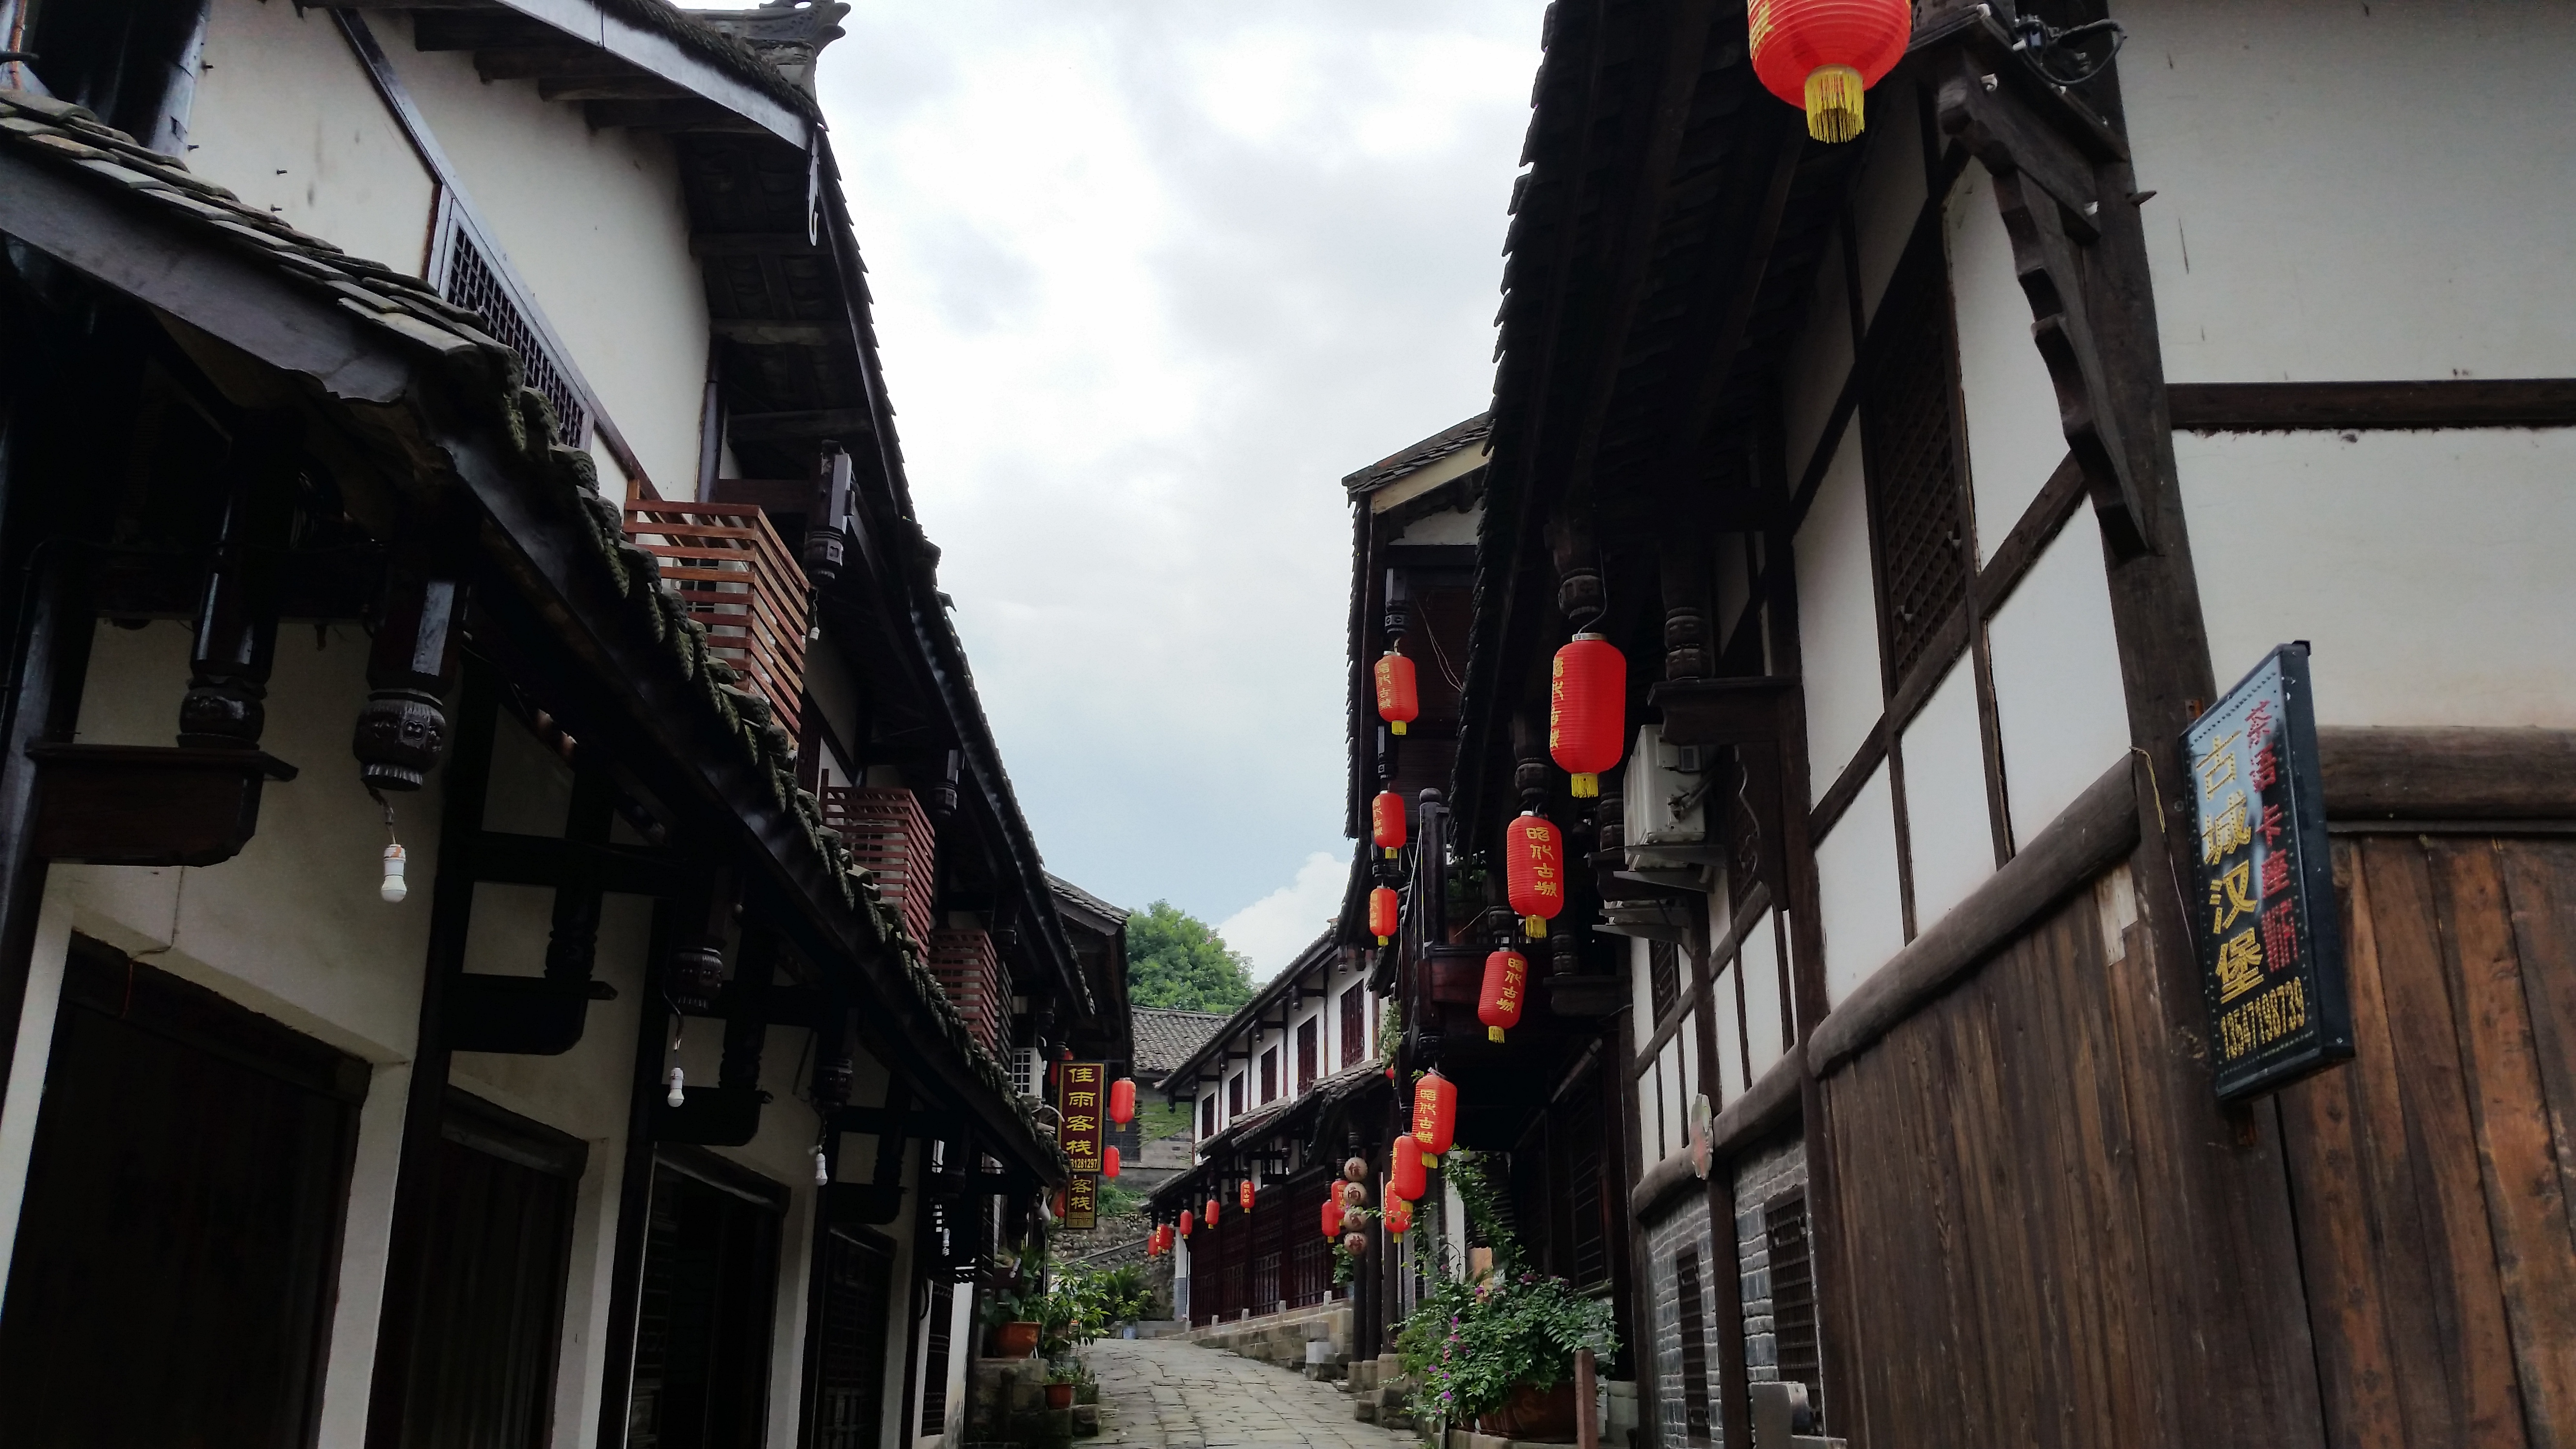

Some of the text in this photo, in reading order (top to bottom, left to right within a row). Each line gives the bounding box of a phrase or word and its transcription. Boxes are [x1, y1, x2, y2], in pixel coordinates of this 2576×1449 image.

[2195, 728, 2265, 1004] 古城汉堡
[2220, 976, 2305, 1061] 13547198739
